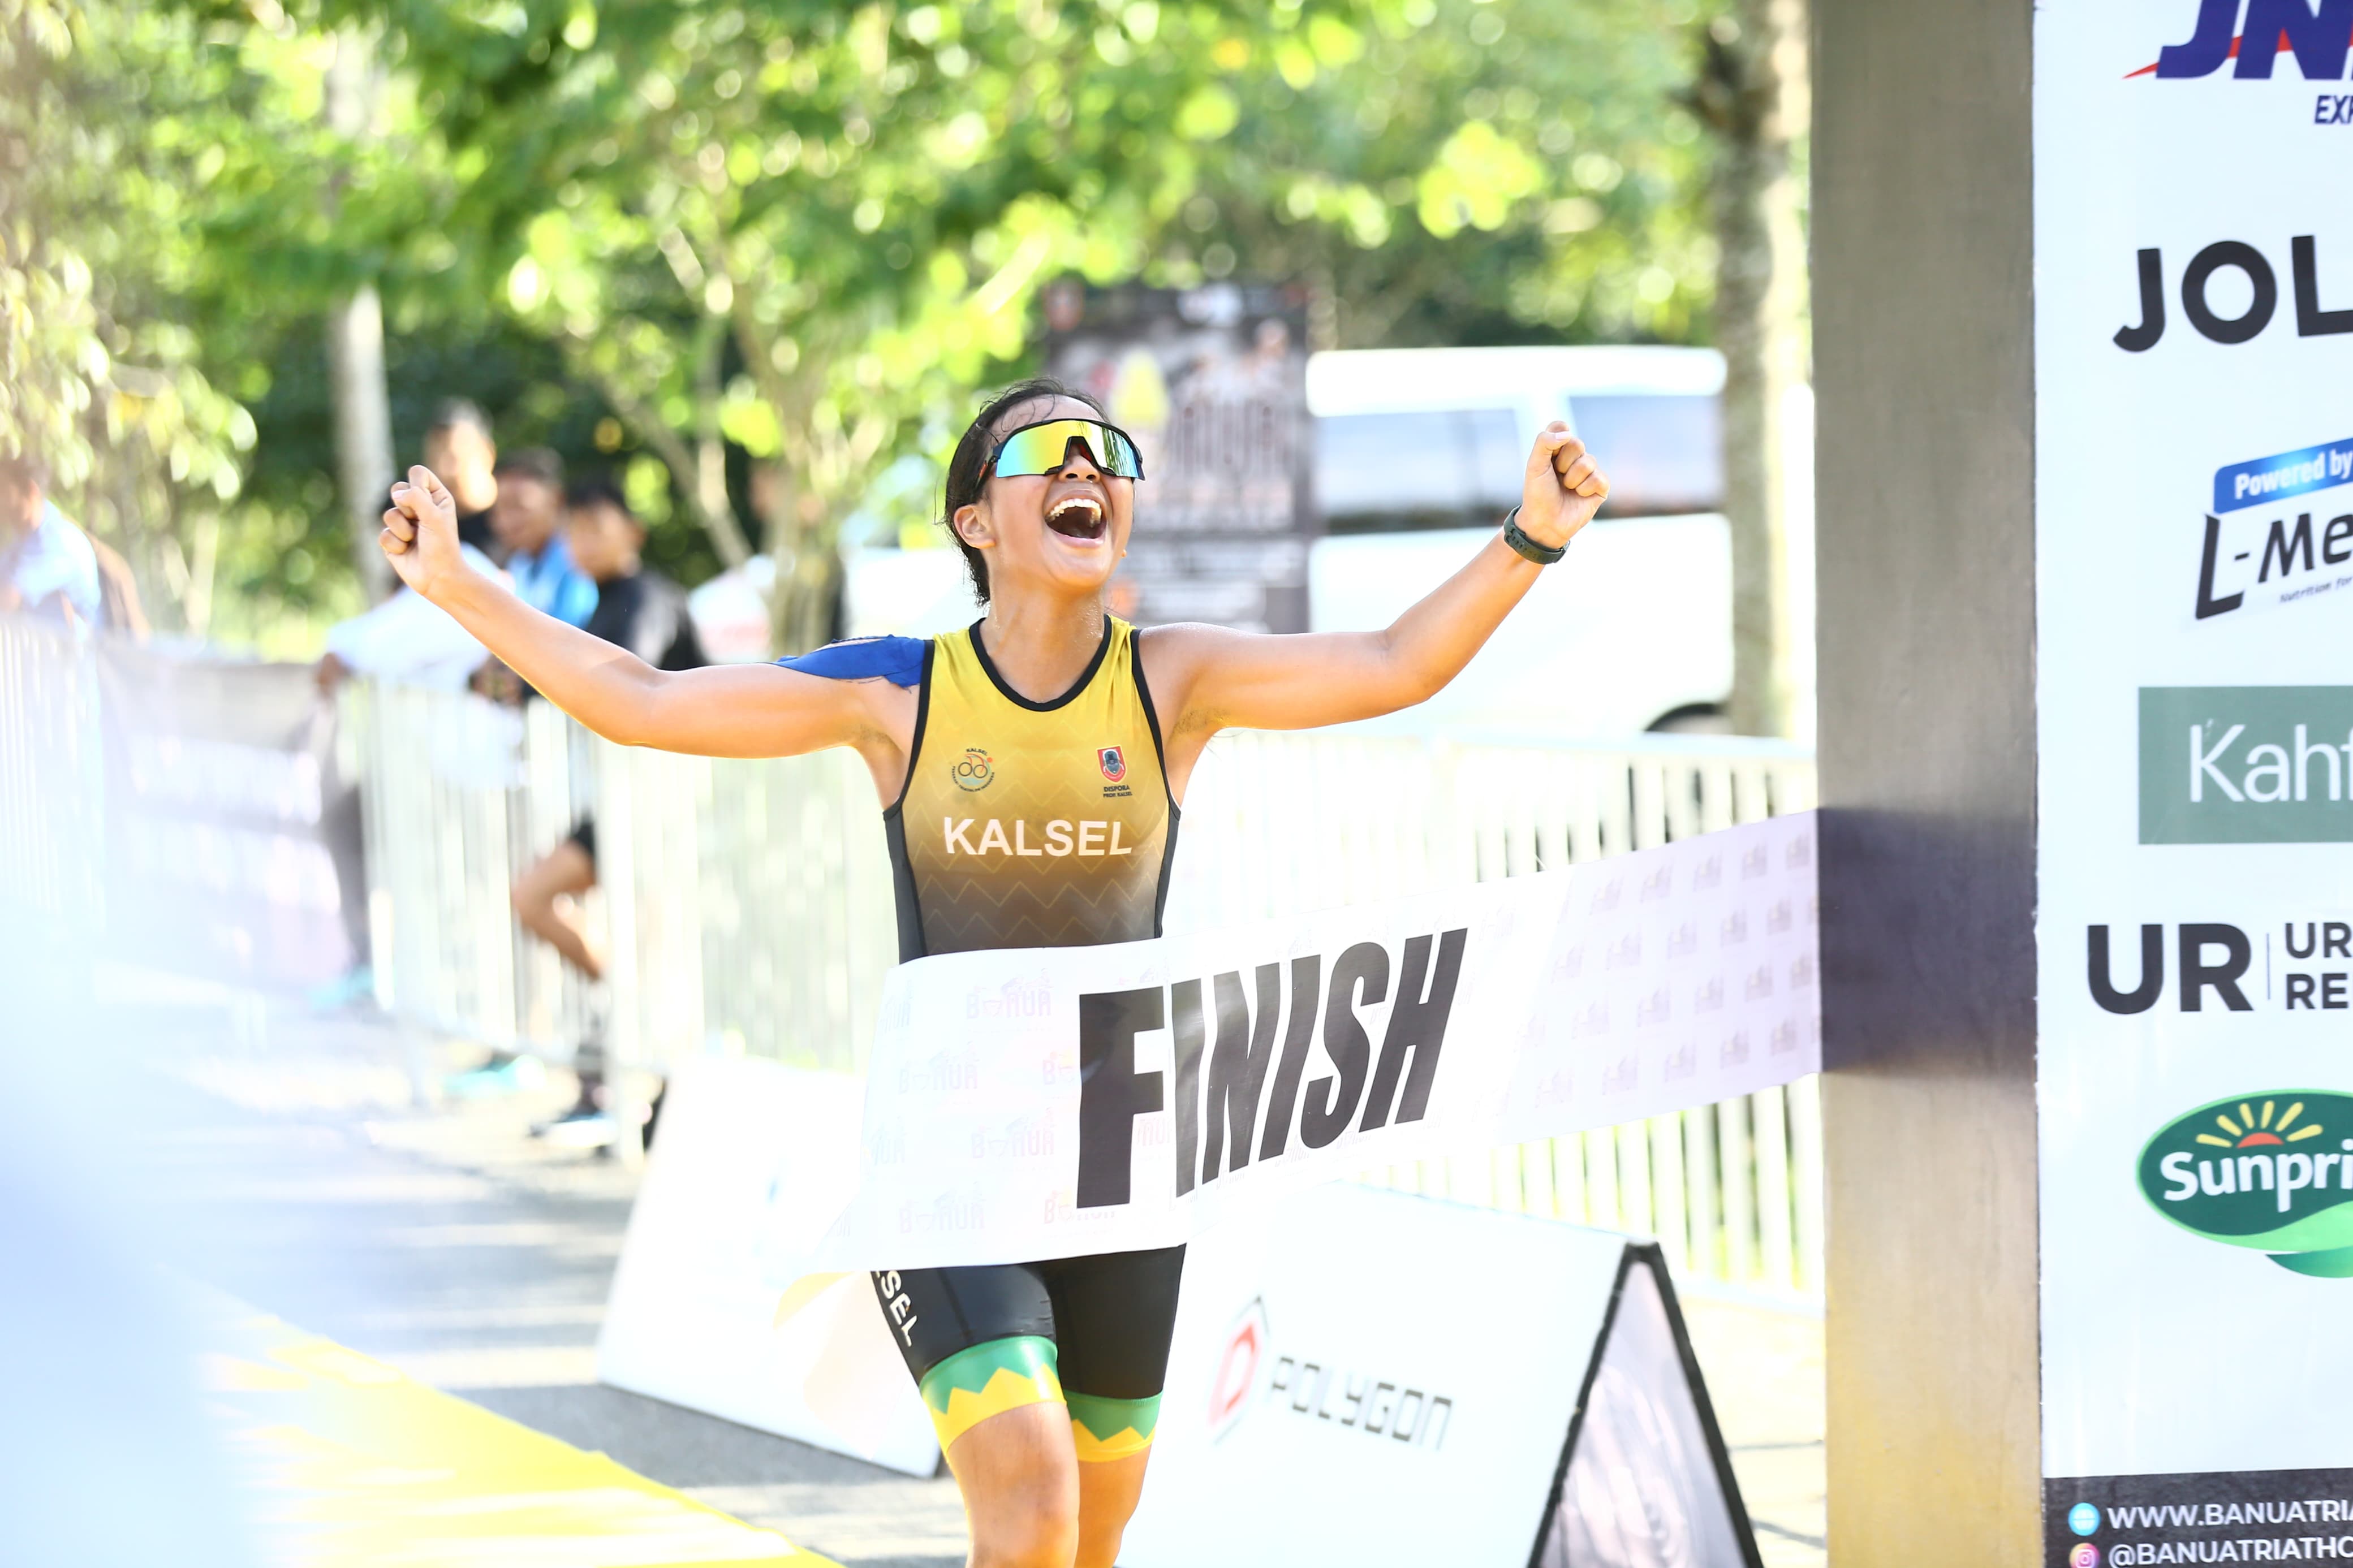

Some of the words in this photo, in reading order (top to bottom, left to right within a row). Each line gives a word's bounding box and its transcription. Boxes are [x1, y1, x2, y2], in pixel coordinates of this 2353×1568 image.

[2156, 0, 2353, 79] JN
[2113, 235, 2353, 352] JOL
[2235, 451, 2325, 500] Powered
[2329, 448, 2353, 480] by
[2195, 513, 2353, 620] L-Me
[2279, 581, 2332, 603] Nutrition
[944, 817, 1132, 857] KALSEL
[2087, 923, 2254, 1015] UR
[2285, 922, 2353, 959] UR
[2286, 973, 2349, 1009] RE
[1077, 928, 1468, 1208] FINISH
[2160, 1139, 2353, 1213] Sunpri
[876, 1270, 917, 1347] SEL
[1270, 1357, 1452, 1449] POLYGON
[2107, 1500, 2353, 1529] WWW.BANUATRI
